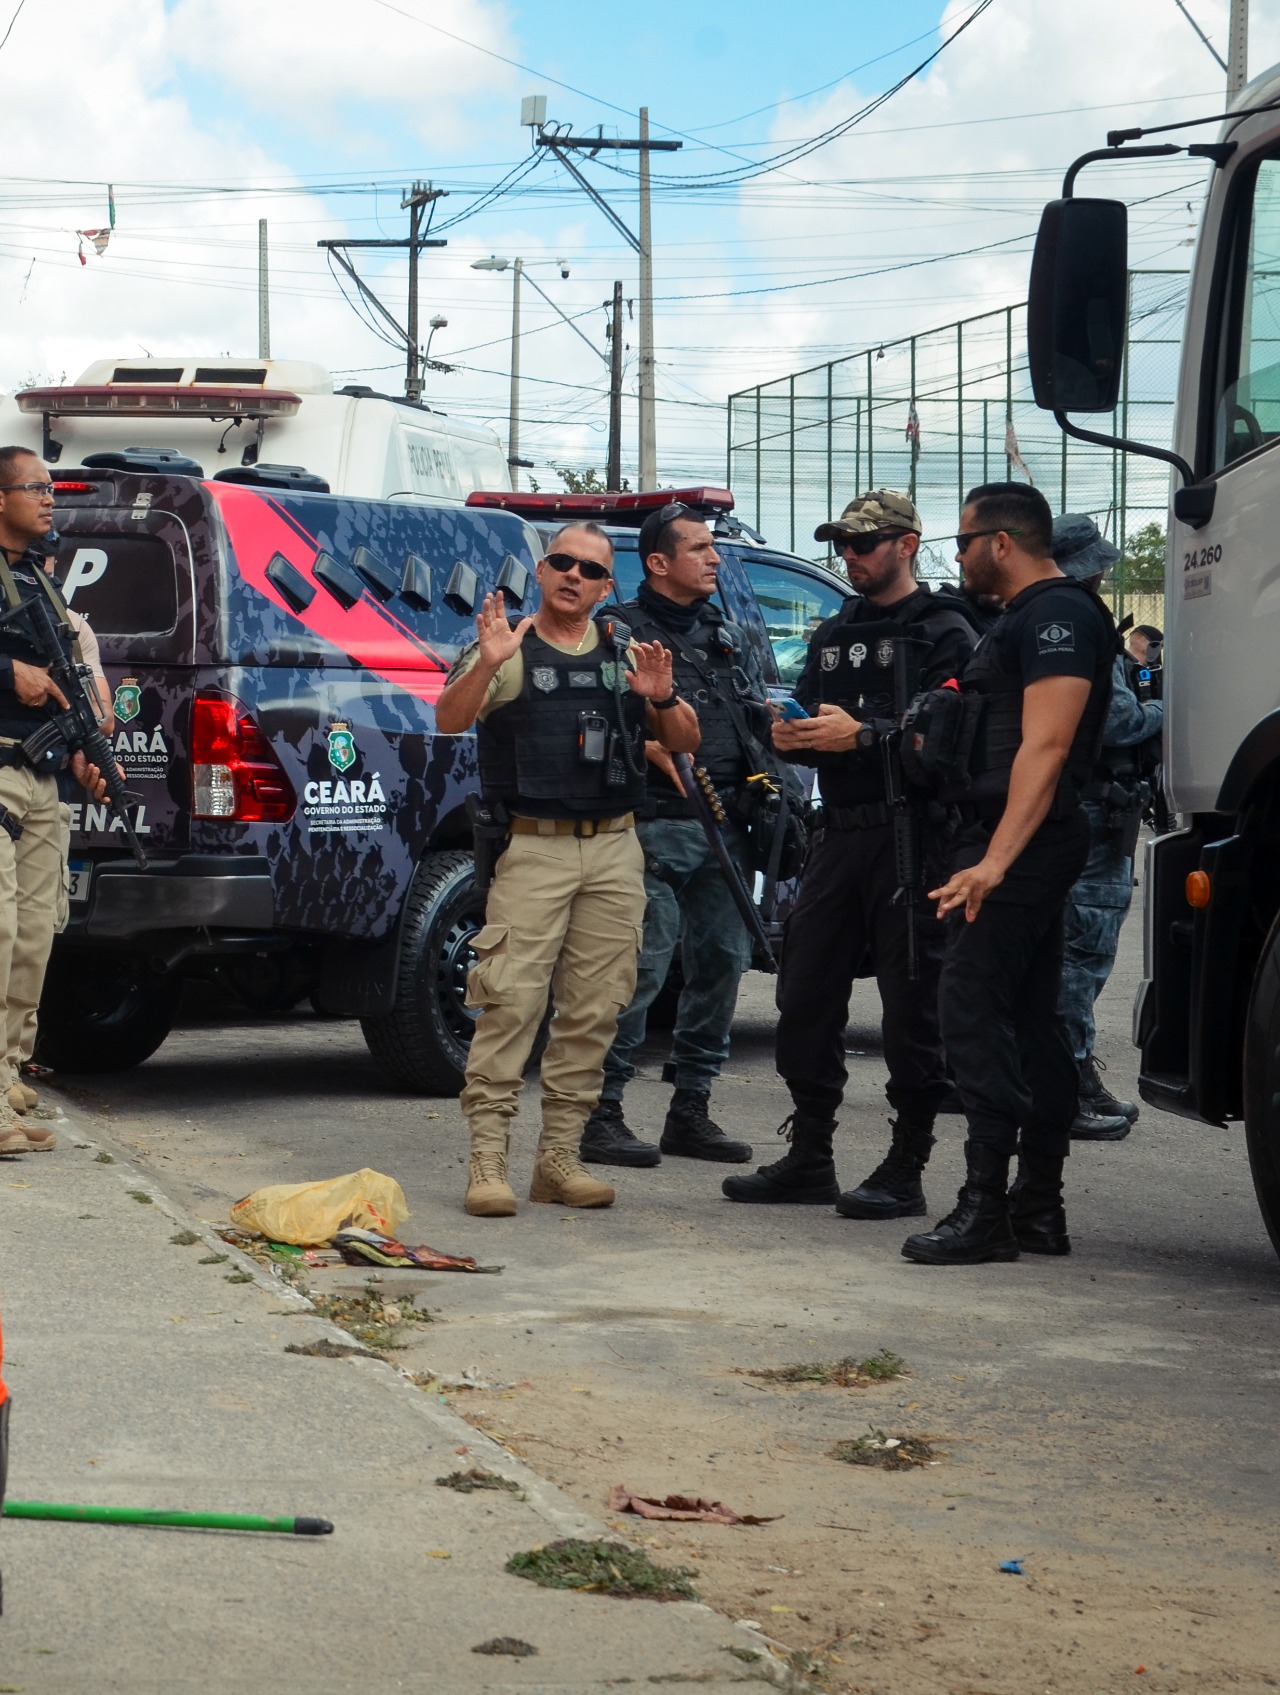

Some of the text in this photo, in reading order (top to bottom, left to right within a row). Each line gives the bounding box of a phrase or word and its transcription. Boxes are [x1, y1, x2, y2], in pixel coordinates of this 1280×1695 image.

[1184, 544, 1222, 571] 24.260
[138, 755, 168, 763] ESTADO
[304, 771, 386, 804] CEARÁ
[68, 803, 151, 833] ENAL
[304, 805, 386, 815] GOVERNO DO ESTADO
